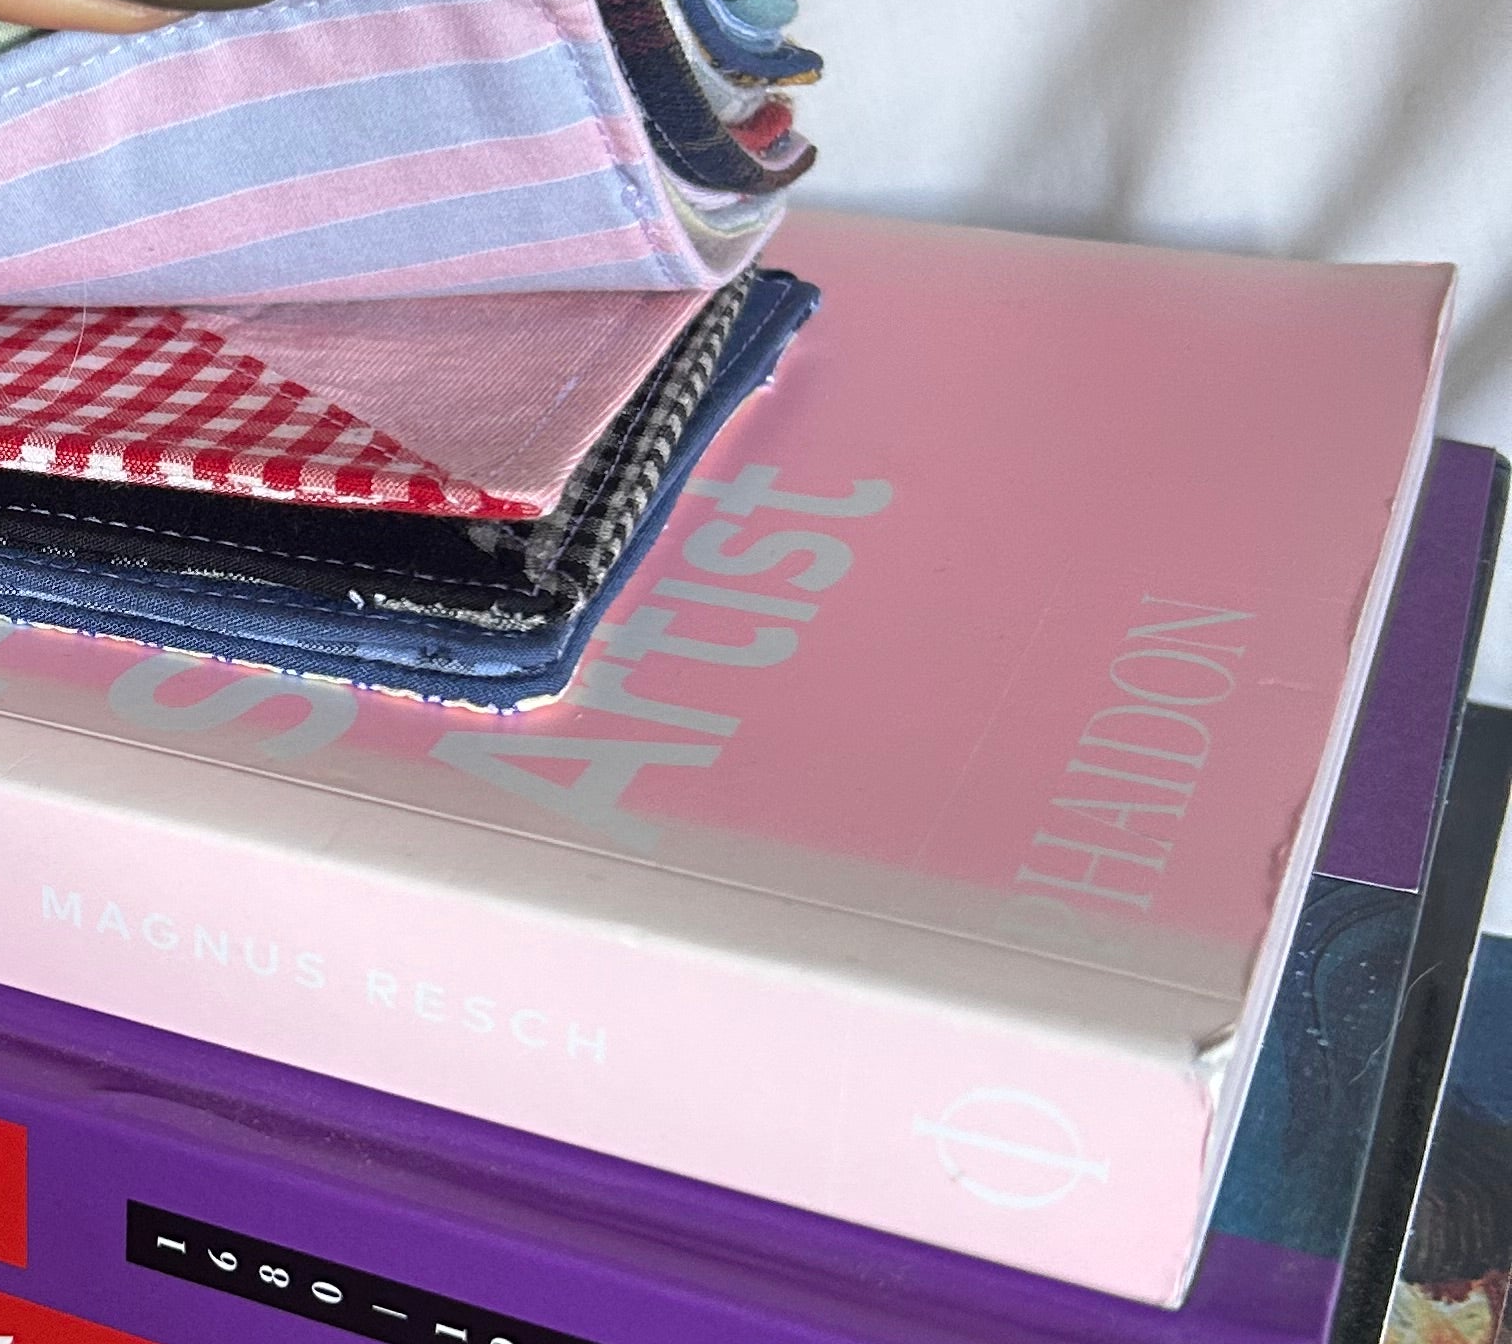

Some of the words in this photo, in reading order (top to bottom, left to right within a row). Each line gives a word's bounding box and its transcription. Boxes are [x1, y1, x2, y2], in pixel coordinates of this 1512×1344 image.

[428, 463, 893, 852] Artist
[988, 593, 1256, 956] PHAIDON
[41, 884, 326, 990] MAGNUS
[366, 968, 610, 1065] RESCH
